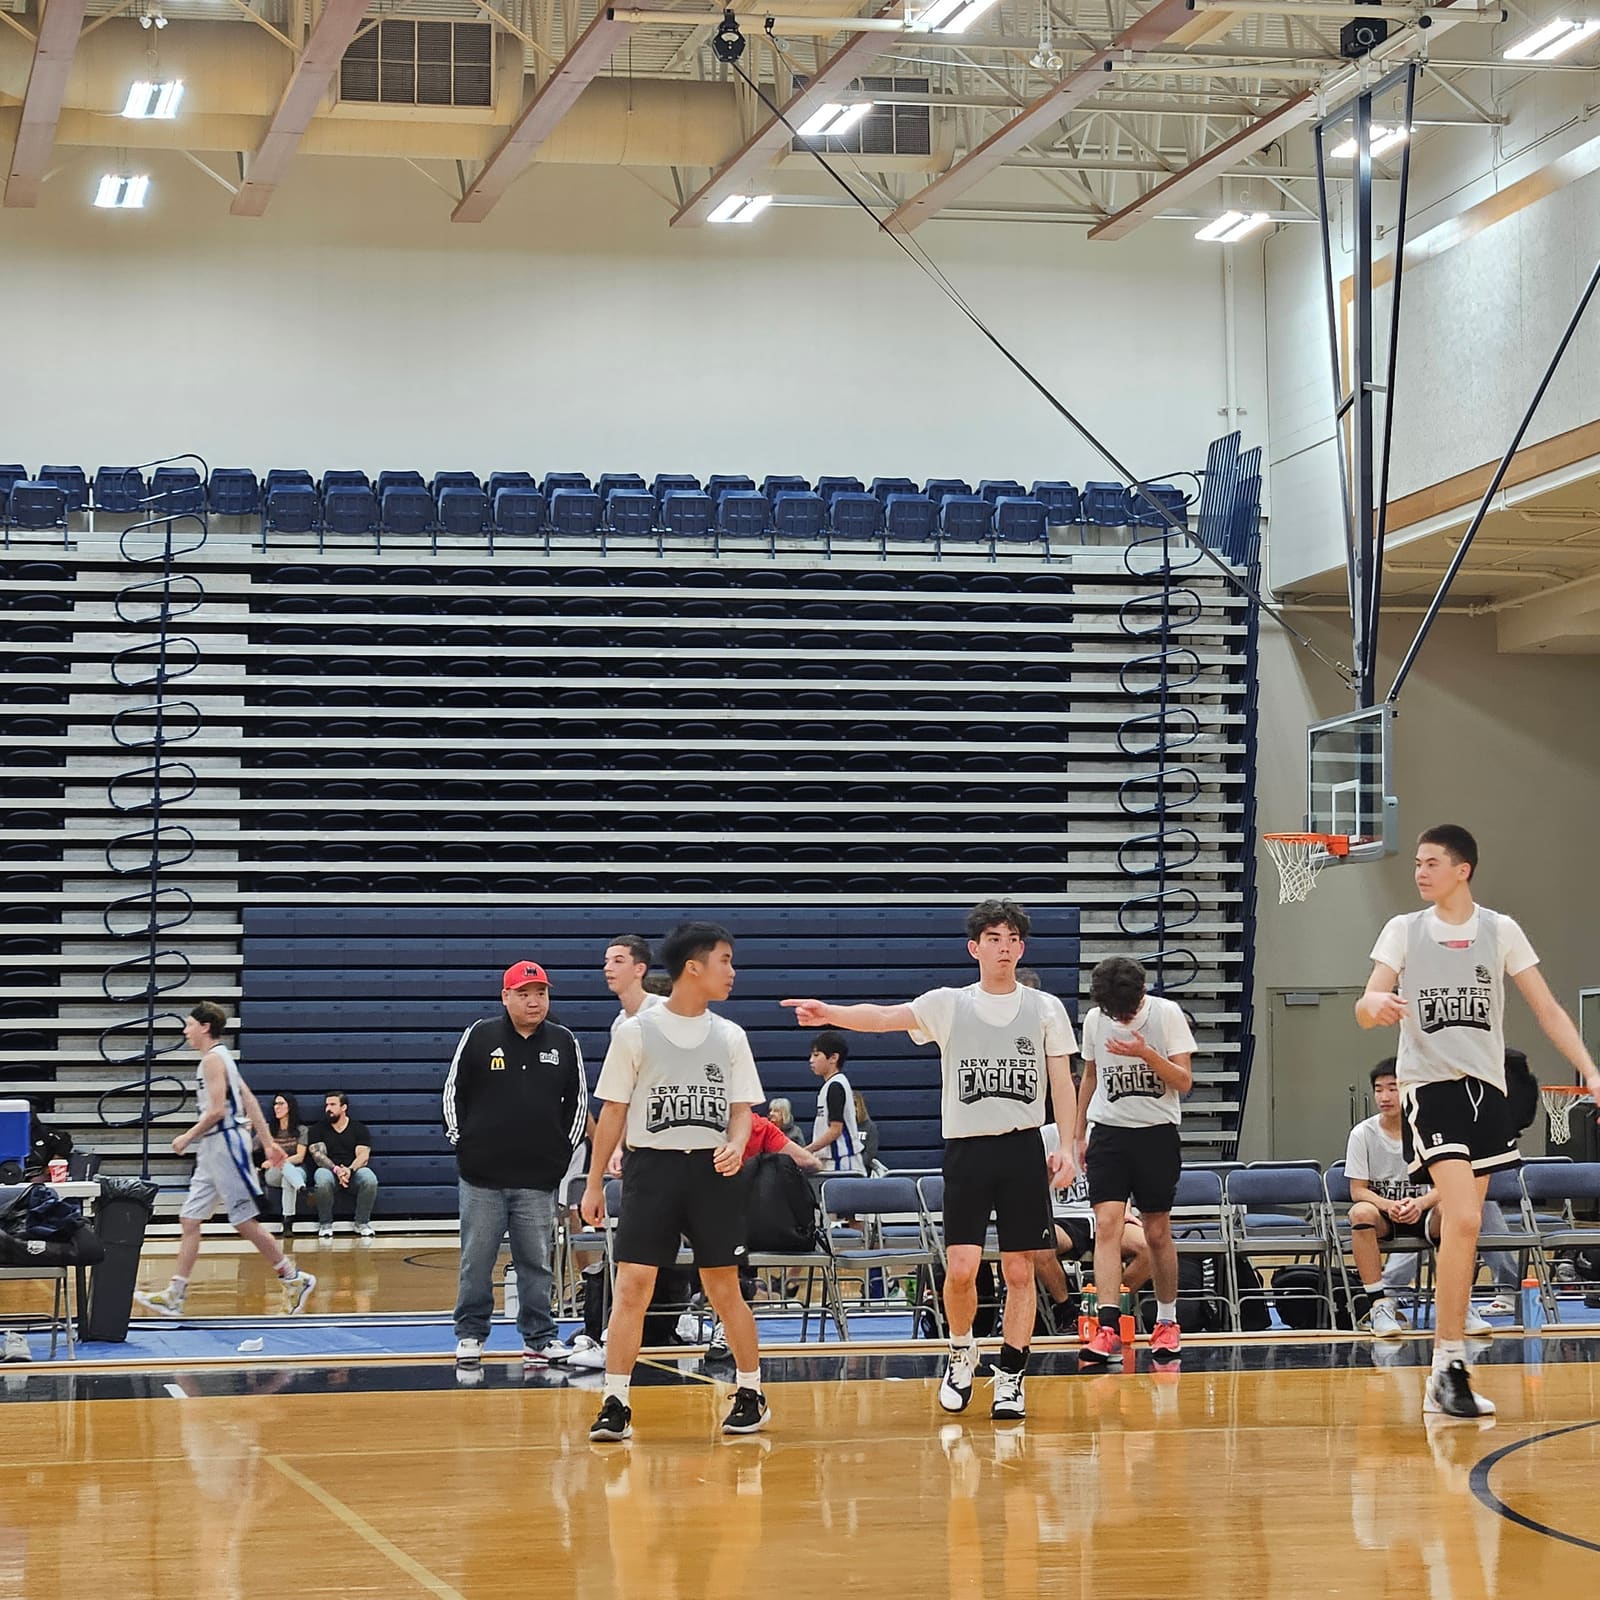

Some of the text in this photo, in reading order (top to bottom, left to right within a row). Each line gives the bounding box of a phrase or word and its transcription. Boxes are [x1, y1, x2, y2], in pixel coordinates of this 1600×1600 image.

[1420, 988, 1449, 997] NEW
[960, 1059, 1036, 1068] NEW WEST
[687, 1085, 725, 1096] WEST
[958, 1067, 1038, 1104] EAGLES
[1103, 1071, 1166, 1103] EAGLES
[646, 1095, 728, 1133] EAGLES
